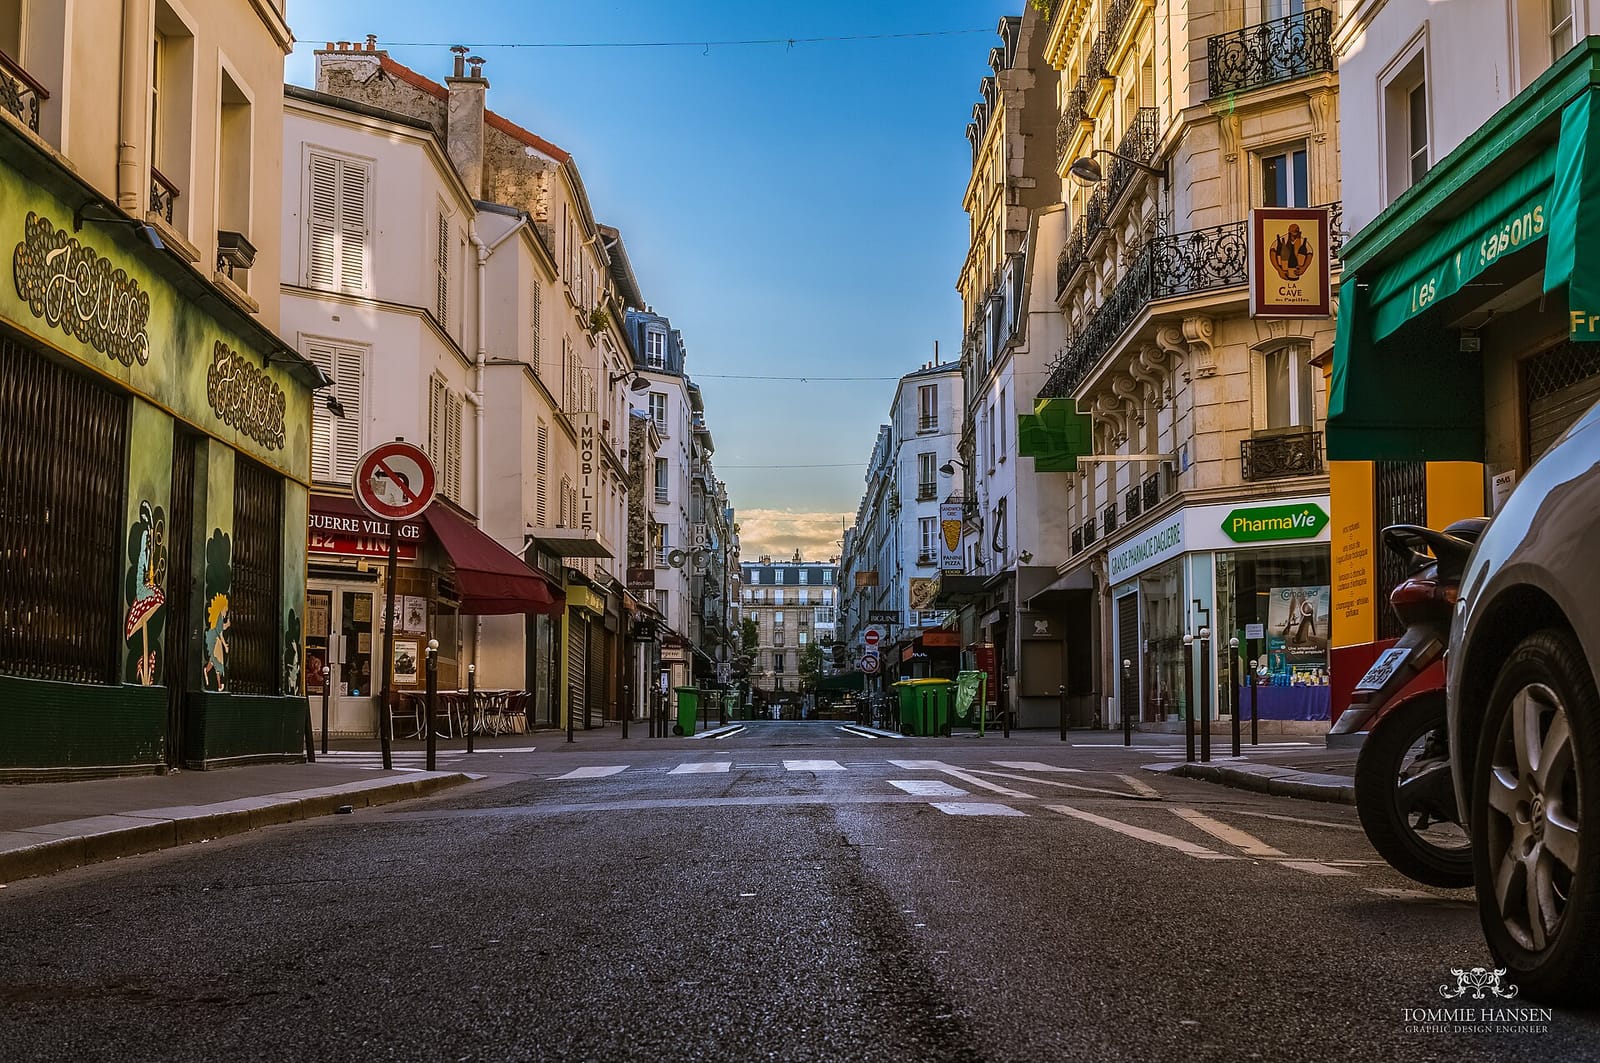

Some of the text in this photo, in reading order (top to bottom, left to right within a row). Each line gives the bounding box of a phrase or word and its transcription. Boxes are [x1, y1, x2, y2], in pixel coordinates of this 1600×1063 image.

[1480, 205, 1544, 266] saisons
[45, 244, 150, 361] Jeux
[1278, 286, 1303, 297] CAVE
[215, 356, 287, 442] Jouets
[362, 520, 420, 539] VILLGE
[1233, 509, 1316, 533] PharmaVie
[1111, 522, 1181, 576] GRANDE PHARMACIE DAGUERRE
